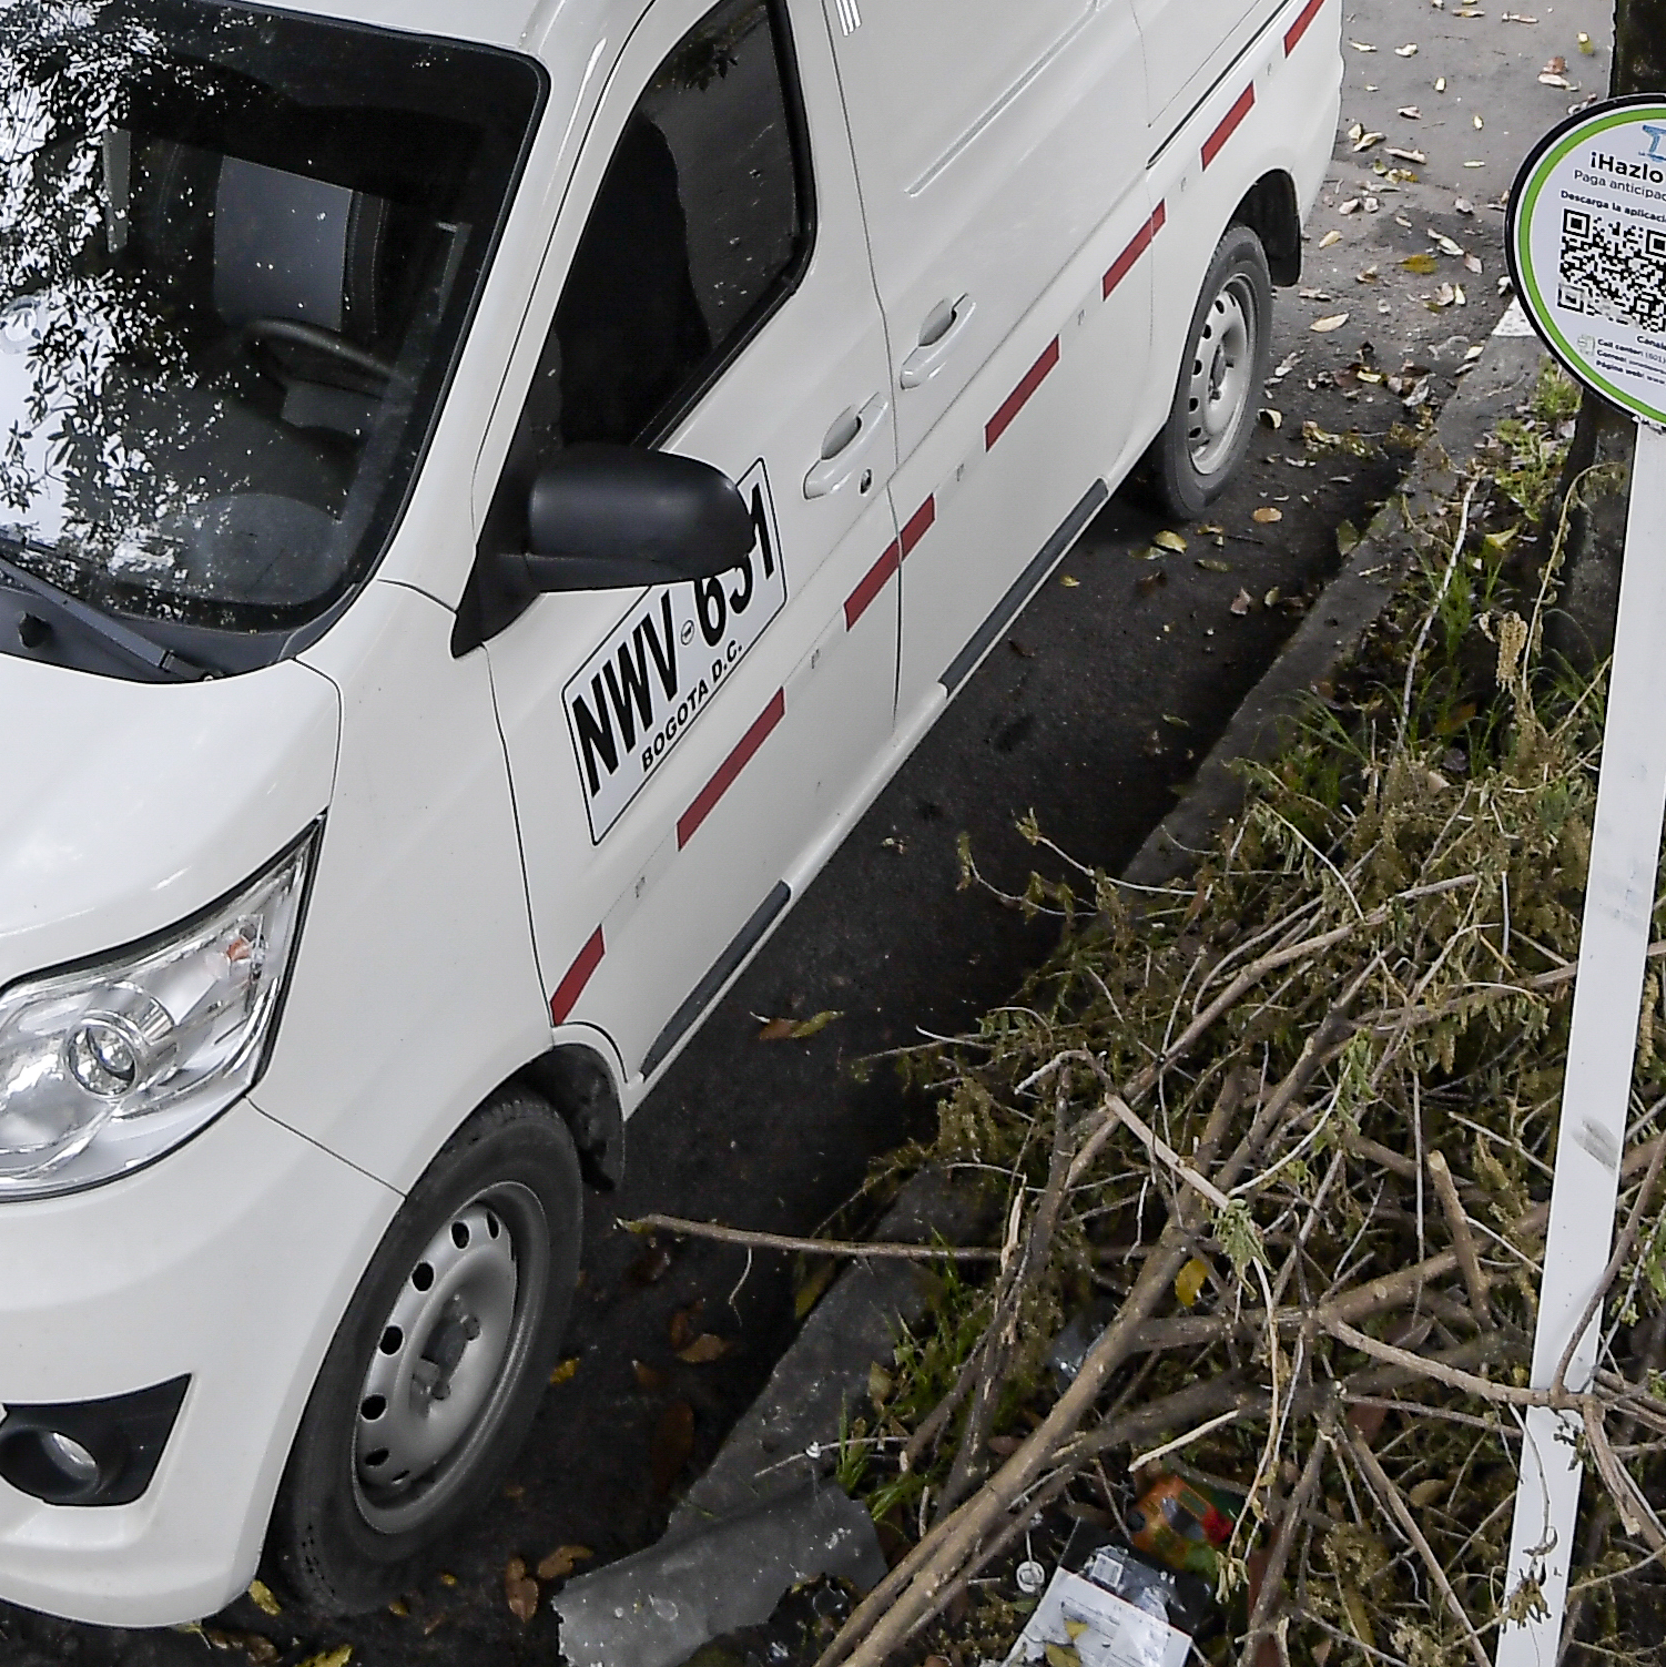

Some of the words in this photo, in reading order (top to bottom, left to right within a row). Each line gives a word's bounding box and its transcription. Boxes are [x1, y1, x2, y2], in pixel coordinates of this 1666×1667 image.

[1560, 189, 1610, 211] Descarga
[1612, 201, 1622, 213] la
[1574, 169, 1606, 188] Paga
[572, 589, 678, 799] NWV
[641, 684, 710, 773] BOGOTA
[712, 643, 743, 686] D.C.
